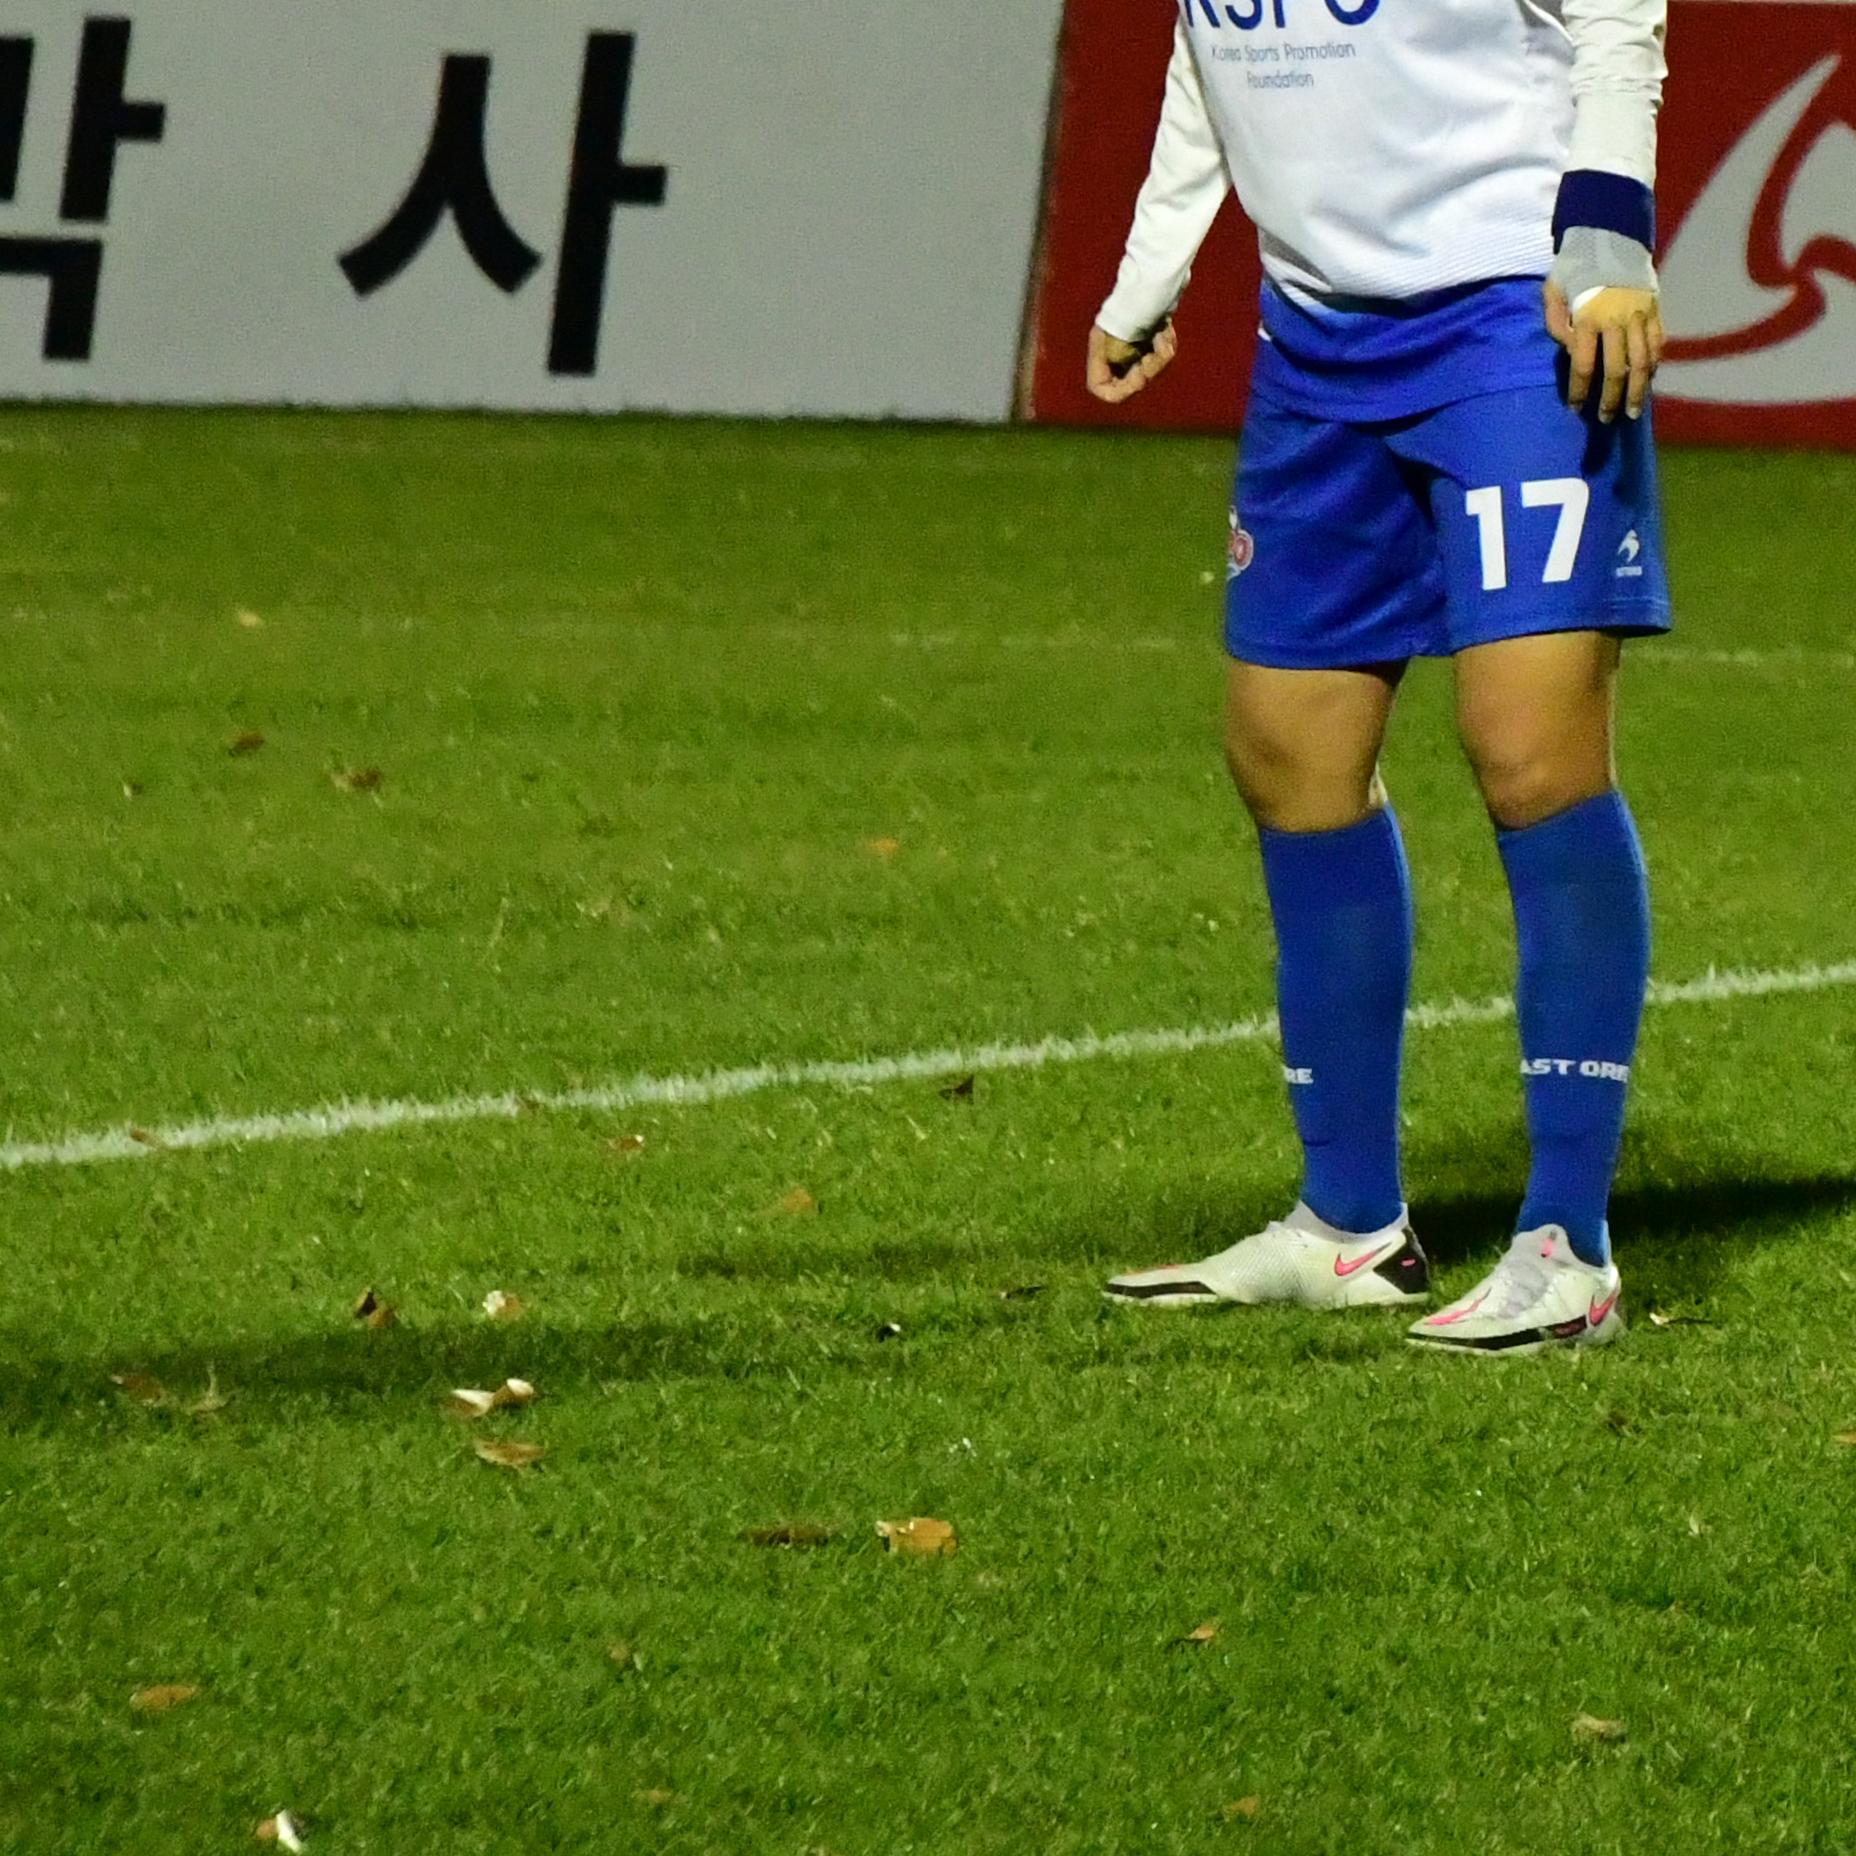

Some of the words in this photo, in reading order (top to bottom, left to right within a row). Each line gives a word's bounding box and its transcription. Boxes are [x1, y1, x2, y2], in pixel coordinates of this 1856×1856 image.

[1211, 45, 1242, 62] Korea
[1244, 44, 1281, 63] Sports
[1284, 41, 1357, 61] Promotion
[1246, 69, 1314, 89] Foundation
[1465, 477, 1590, 591] 17
